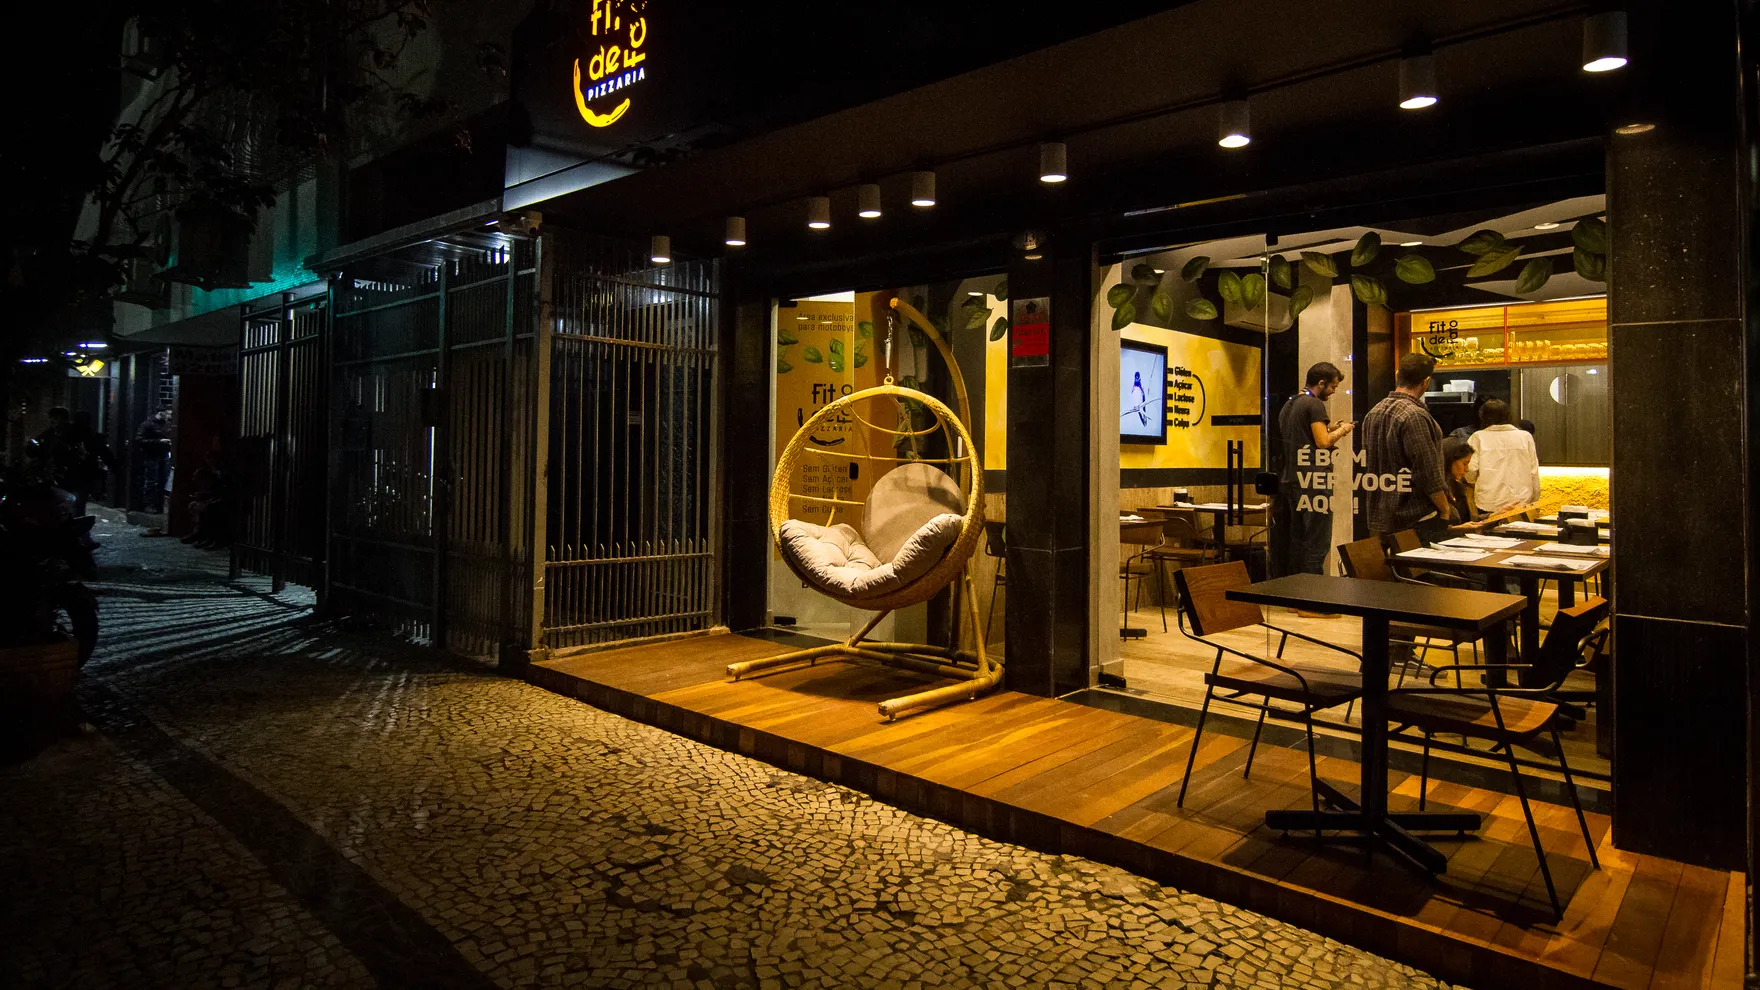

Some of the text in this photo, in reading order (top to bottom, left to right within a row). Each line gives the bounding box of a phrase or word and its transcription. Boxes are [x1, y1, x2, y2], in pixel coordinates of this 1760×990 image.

[589, 45, 621, 80] de
[586, 66, 646, 102] PIZZARIA
[818, 312, 854, 322] exclusiva
[798, 323, 816, 333] para
[1429, 321, 1446, 333] Fit
[1429, 335, 1445, 344] de
[812, 384, 836, 404] Fit
[1174, 392, 1195, 404] Lactose
[1296, 444, 1311, 466] É
[803, 464, 820, 473] Sem
[803, 474, 848, 485] Sem Açcar
[1296, 467, 1413, 493] VER VOCÊ
[803, 484, 820, 493] Sem
[802, 504, 819, 513] Sem
